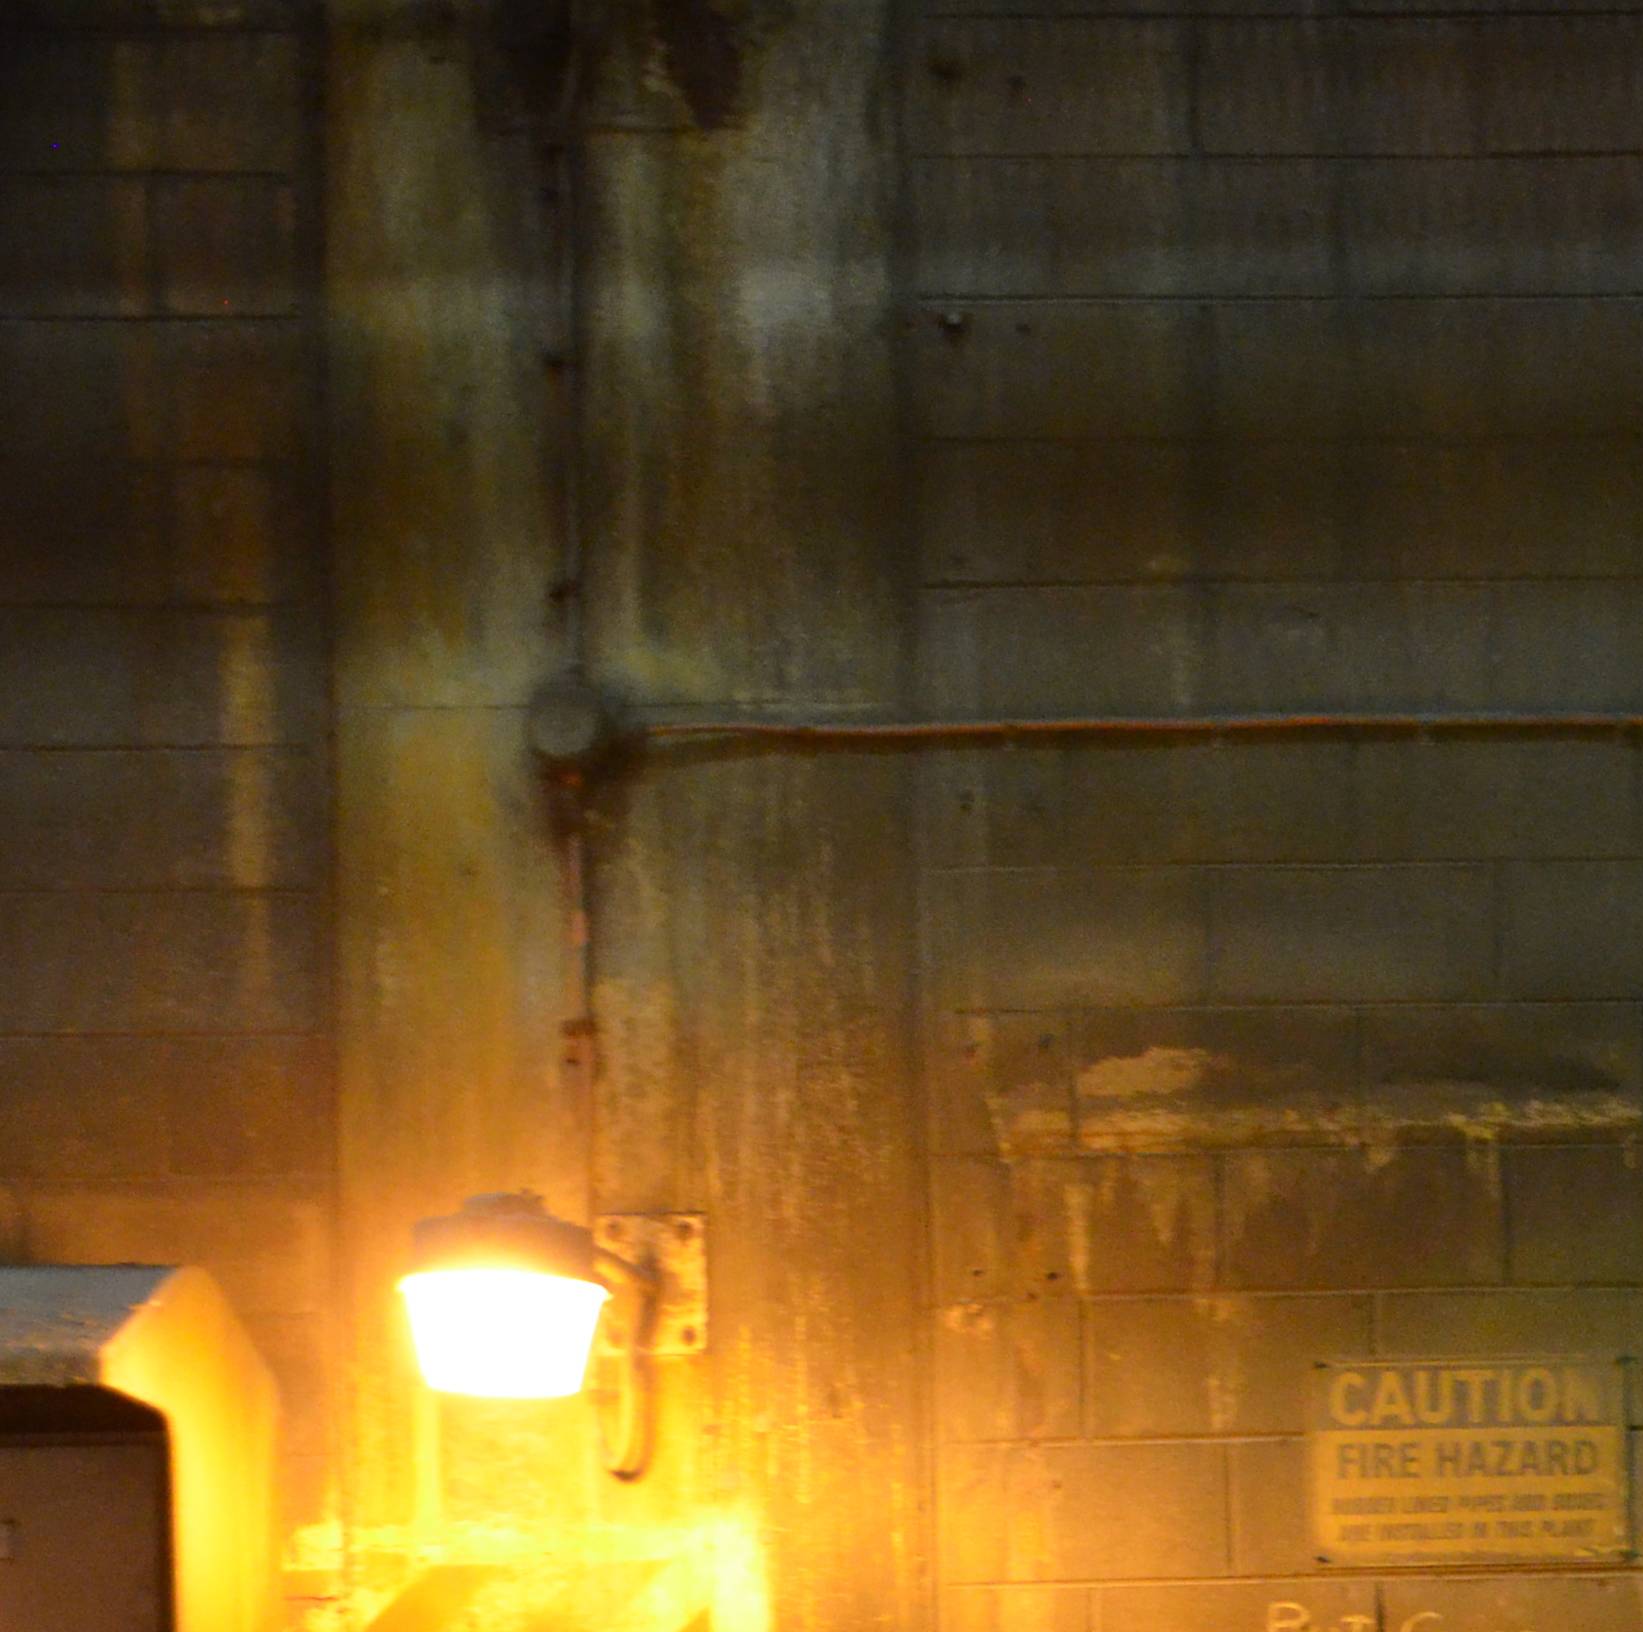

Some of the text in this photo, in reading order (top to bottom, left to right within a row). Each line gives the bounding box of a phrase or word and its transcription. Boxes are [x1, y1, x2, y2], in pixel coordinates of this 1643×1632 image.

[1329, 1368, 1600, 1426] CAUTION
[1337, 1439, 1599, 1479] FIRE HAZARD
